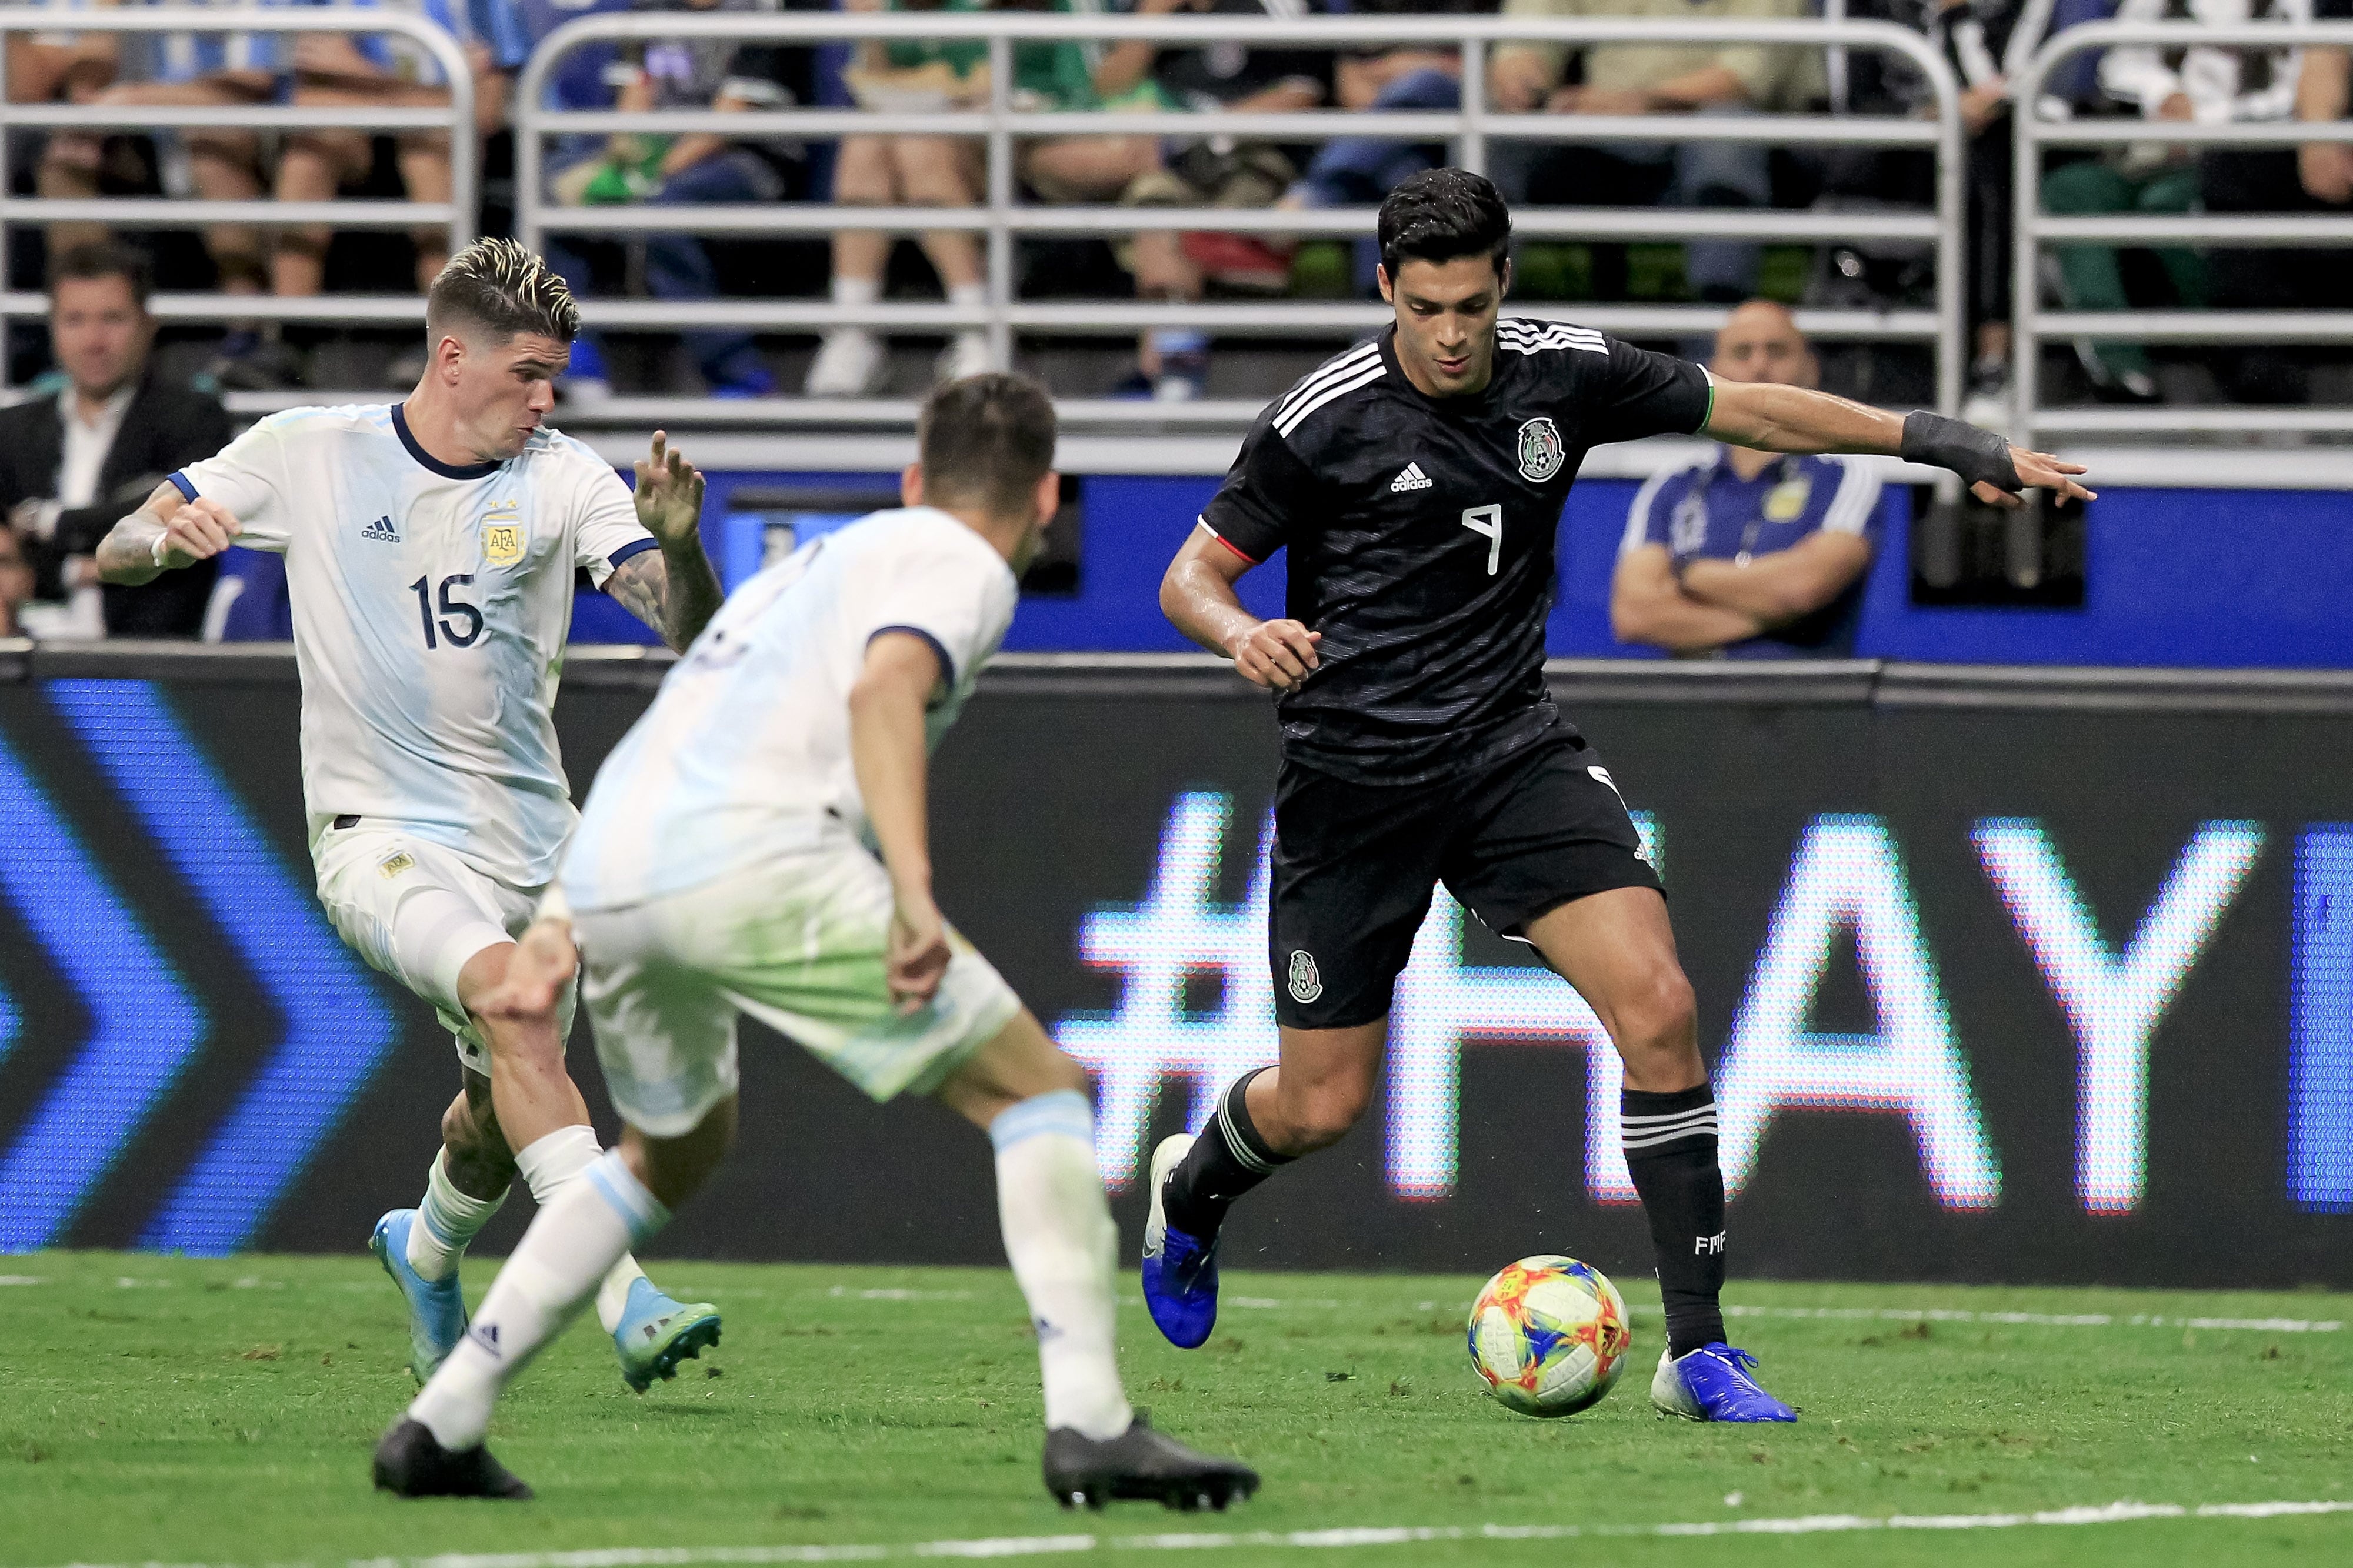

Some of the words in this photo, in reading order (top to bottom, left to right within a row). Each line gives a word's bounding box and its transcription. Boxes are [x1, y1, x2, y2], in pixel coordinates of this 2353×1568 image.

[1391, 478, 1432, 492] adidas
[361, 529, 400, 543] adidas
[490, 529, 516, 551] AFA
[1462, 503, 1501, 575] 9
[409, 574, 484, 650] 15
[1695, 1230, 1726, 1255] FMF
